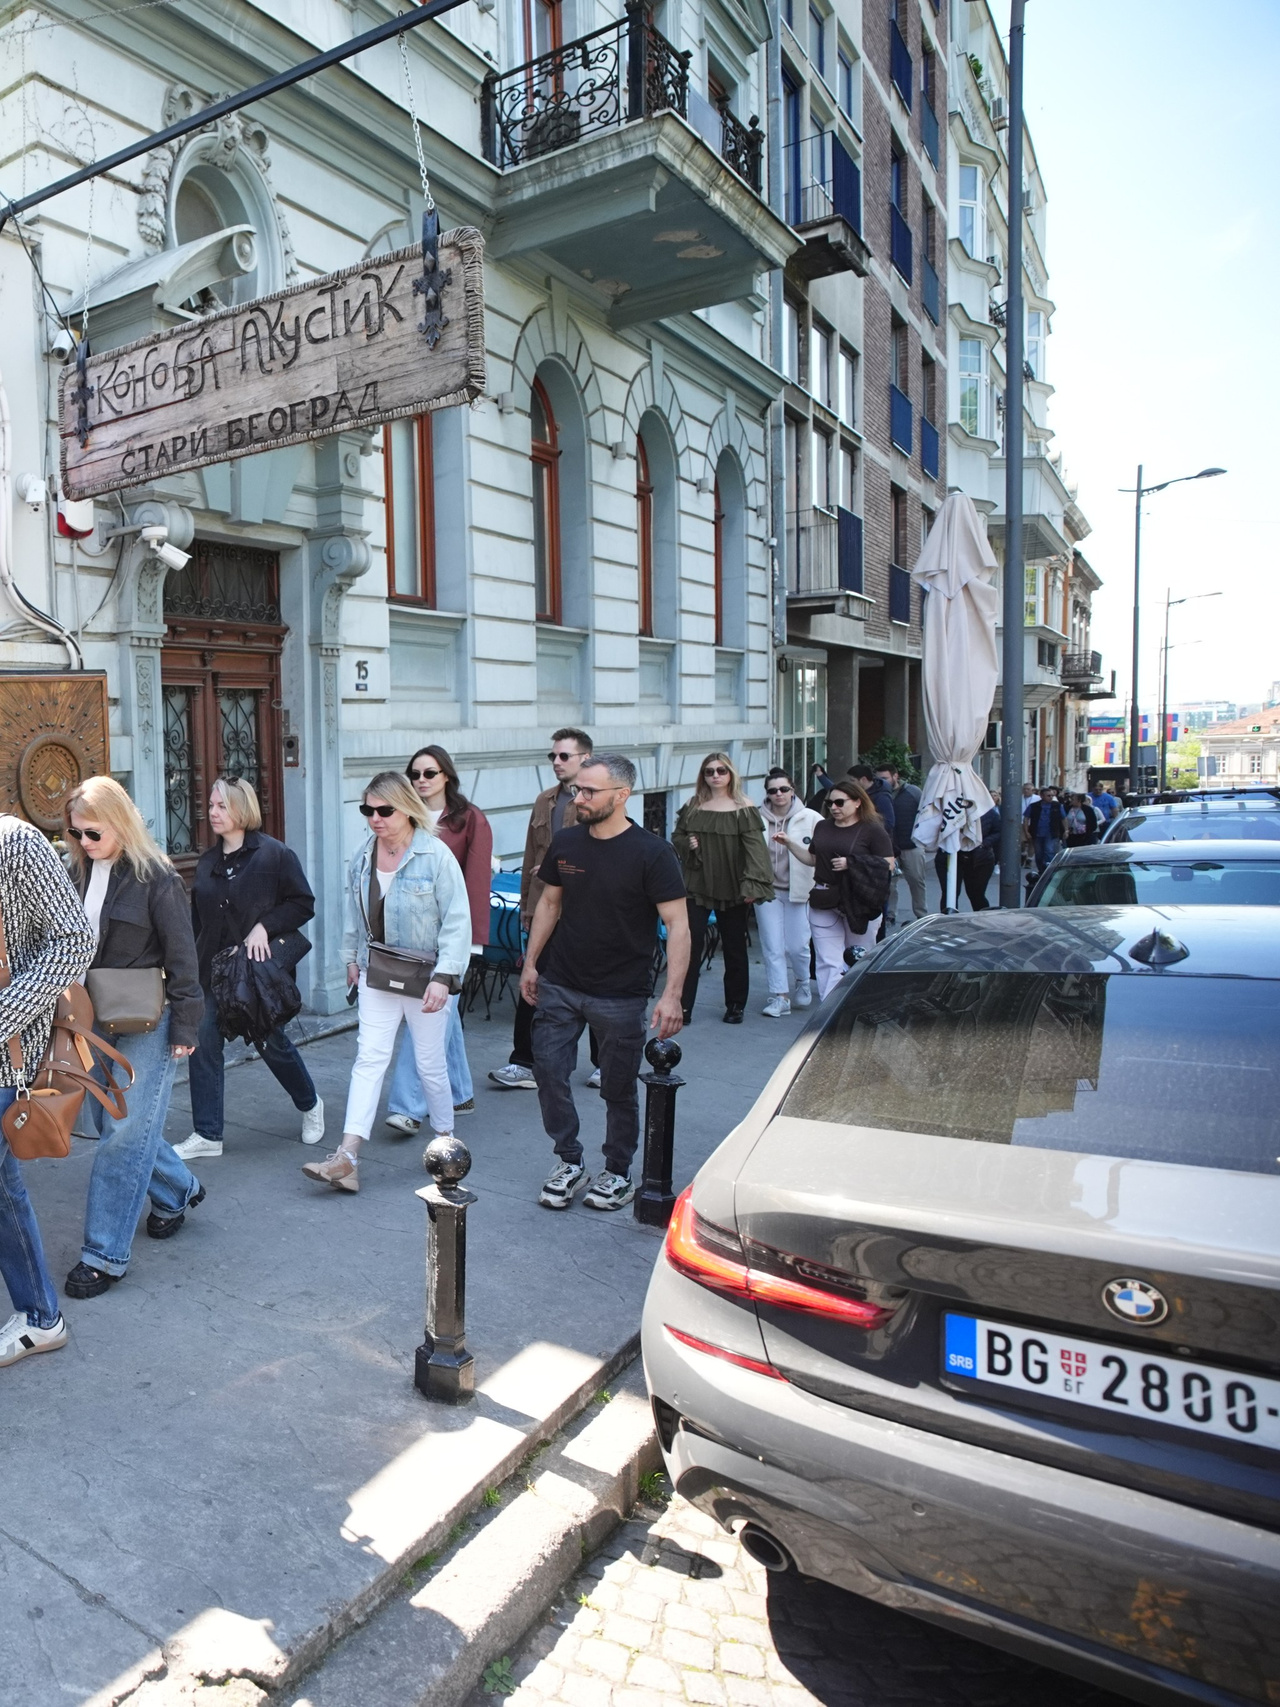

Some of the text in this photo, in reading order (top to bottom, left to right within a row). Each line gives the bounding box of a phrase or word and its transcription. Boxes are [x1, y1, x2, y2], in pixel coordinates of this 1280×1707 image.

[121, 381, 379, 475] СТАРИ БЕОГРАД
[355, 660, 368, 680] 15
[1108, 1281, 1161, 1302] BMW
[949, 1353, 974, 1370] SRB
[986, 1329, 1049, 1385] BG
